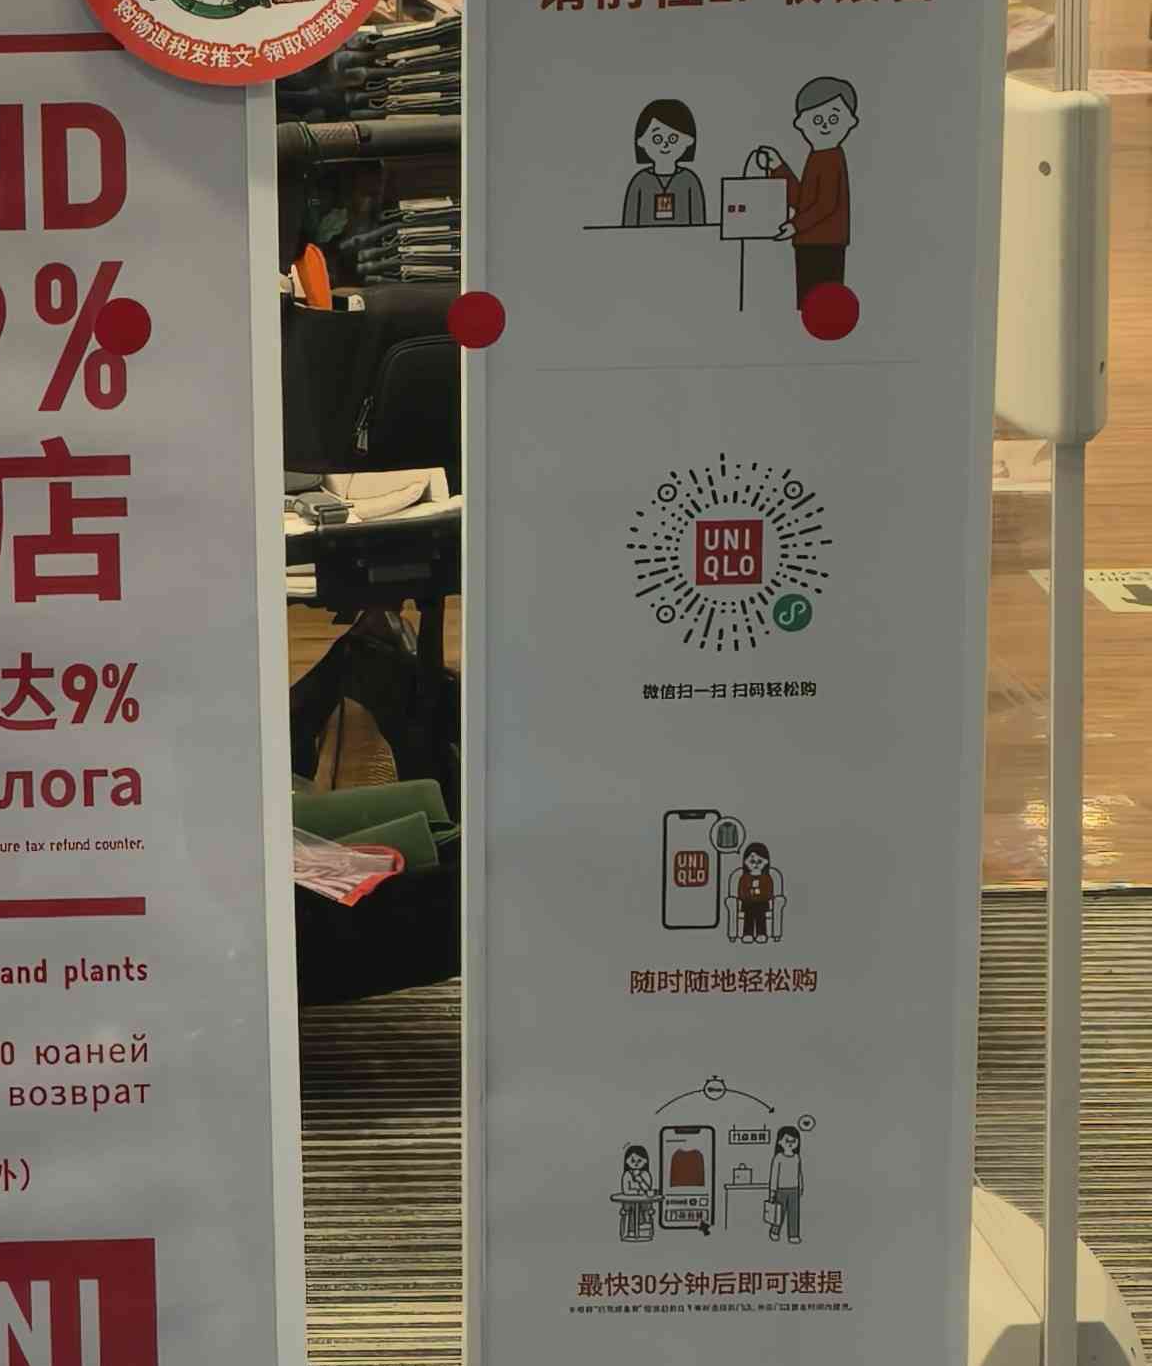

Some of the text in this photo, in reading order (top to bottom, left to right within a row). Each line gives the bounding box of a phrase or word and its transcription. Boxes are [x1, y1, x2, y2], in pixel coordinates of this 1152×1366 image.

[704, 528, 750, 550] UNI
[704, 555, 755, 581] QLO
[732, 681, 817, 699] 扫码轻松购
[26, 841, 44, 851] tax
[677, 853, 704, 868] UNI
[1, 959, 47, 984] and
[65, 957, 147, 990] plants
[630, 968, 817, 994] 随时随地轻松购
[36, 1034, 147, 1065] юаней
[10, 1084, 150, 1112] возврат
[577, 1270, 844, 1298] 最快30分钟后即可速提
